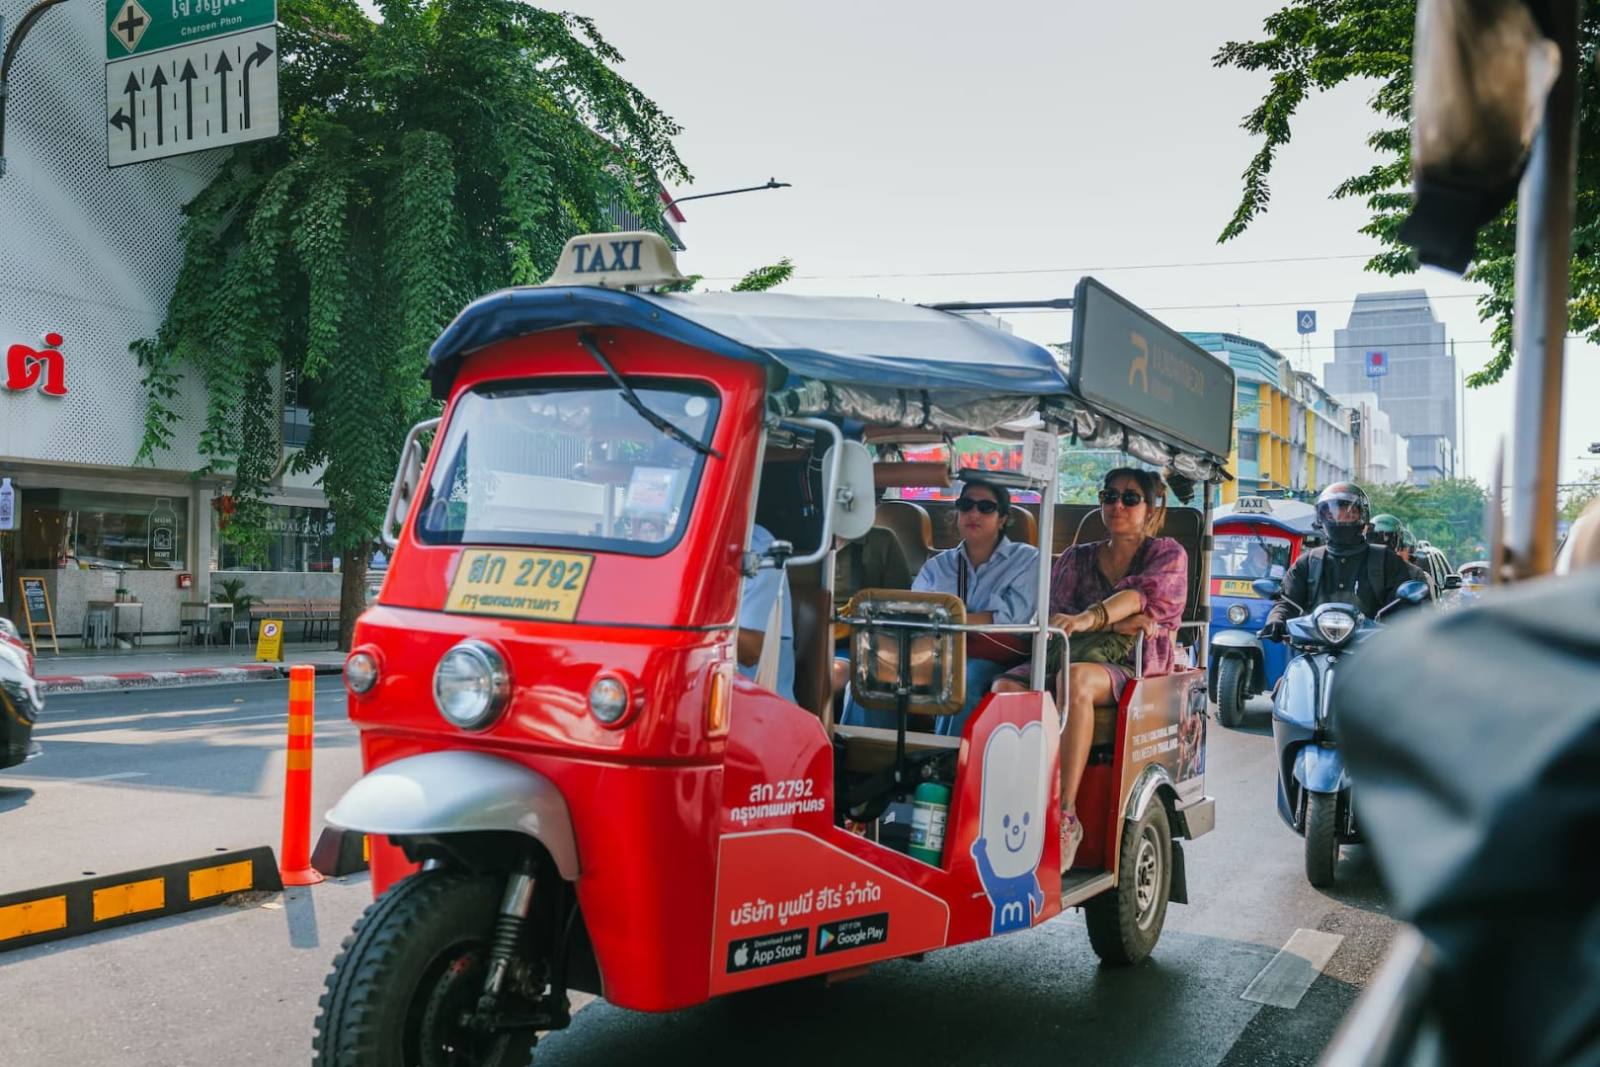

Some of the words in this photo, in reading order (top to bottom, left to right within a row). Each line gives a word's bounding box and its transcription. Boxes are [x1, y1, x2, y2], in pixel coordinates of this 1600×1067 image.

[181, 22, 216, 36] Charoen
[220, 16, 242, 27] Phon
[572, 240, 643, 274] TAXI
[1240, 500, 1263, 508] TAXI
[514, 558, 583, 591] 2792
[749, 783, 773, 803] สก
[776, 778, 813, 799] 2792
[730, 798, 826, 827] กรุงเทพมหานคร
[730, 898, 775, 926] บริษัท
[845, 880, 882, 906] จำกัด
[754, 936, 784, 948] Download
[837, 930, 866, 945] Google
[868, 926, 884, 940] Play
[752, 950, 774, 965] App
[775, 945, 802, 959] Store
